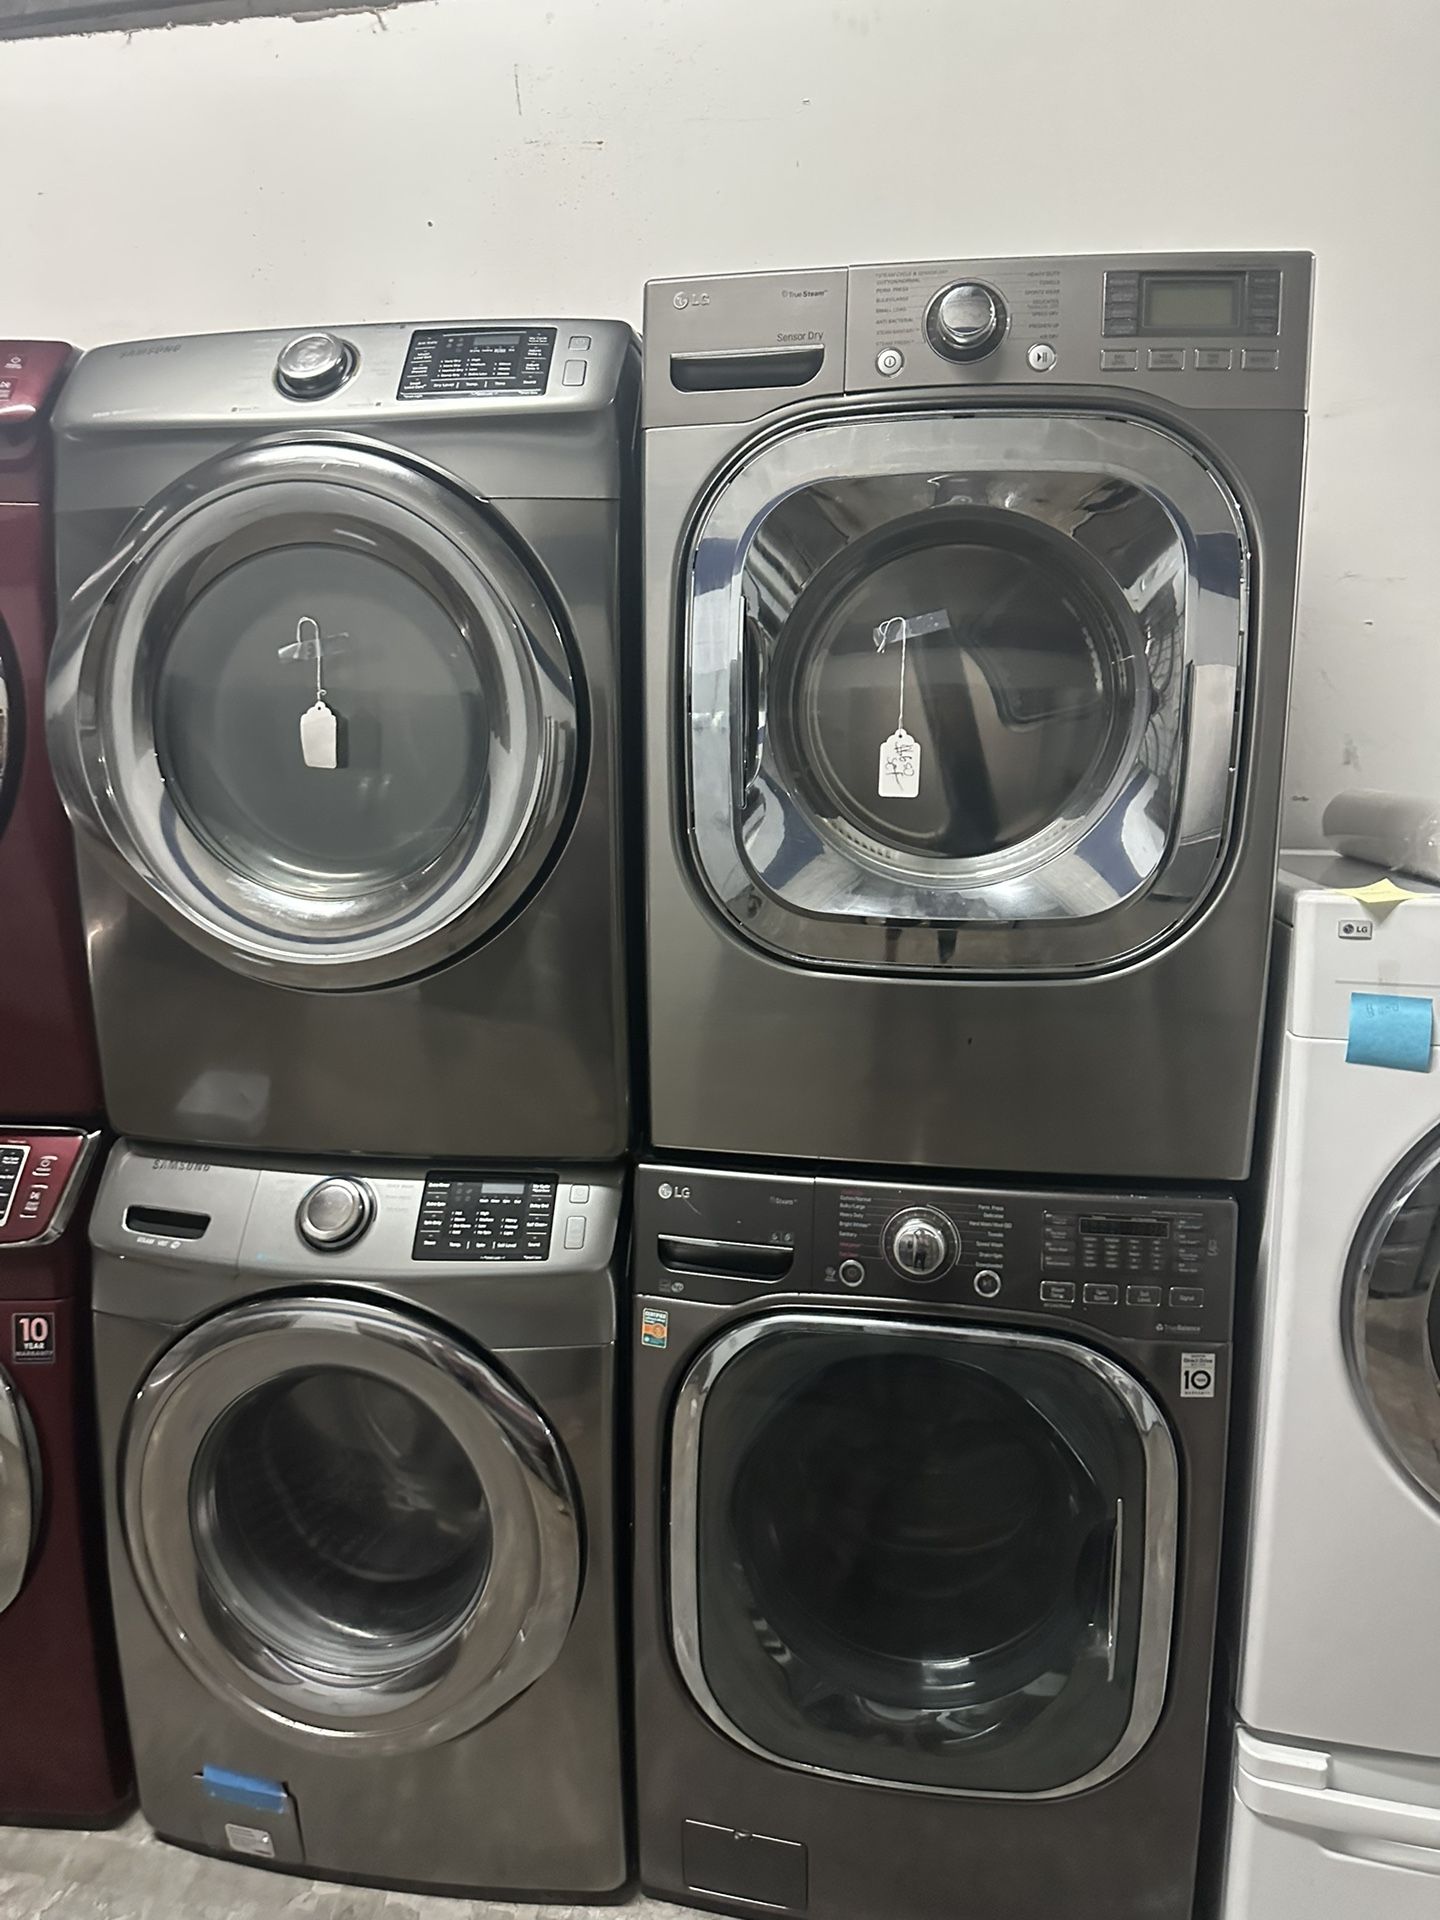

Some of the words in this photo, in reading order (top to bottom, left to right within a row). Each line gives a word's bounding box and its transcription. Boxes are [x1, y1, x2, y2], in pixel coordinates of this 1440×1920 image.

[691, 293, 711, 306] LG
[777, 332, 806, 342] Sensor
[808, 330, 824, 341] Dry
[152, 1155, 211, 1173] SAMSUNG
[673, 1186, 691, 1199] LG
[19, 1317, 49, 1342] 10
[24, 1342, 45, 1350] YEAR
[1184, 1370, 1212, 1390] 10
